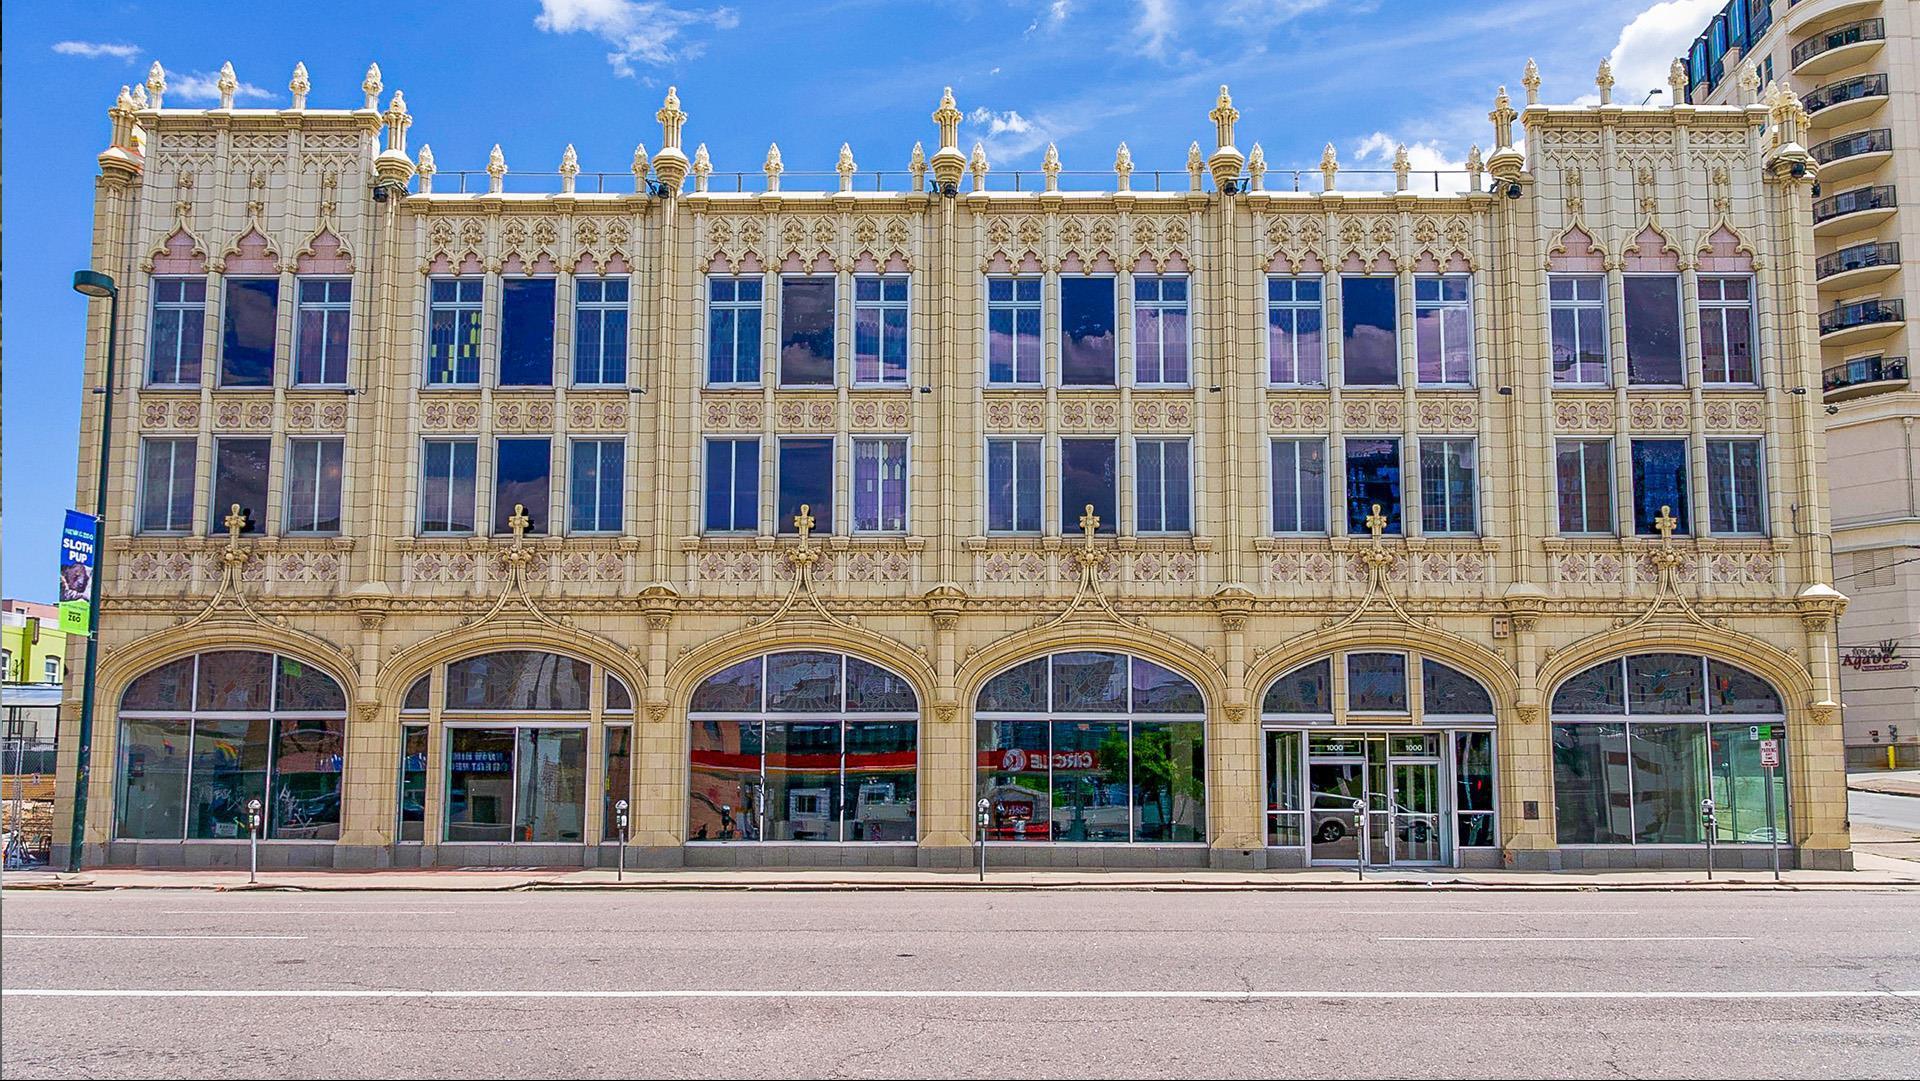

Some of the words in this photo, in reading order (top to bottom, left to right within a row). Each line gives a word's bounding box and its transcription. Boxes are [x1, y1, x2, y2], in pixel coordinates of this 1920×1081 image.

[63, 538, 93, 554] SLOTH
[69, 550, 88, 563] PUP
[1841, 652, 1890, 670] Agave
